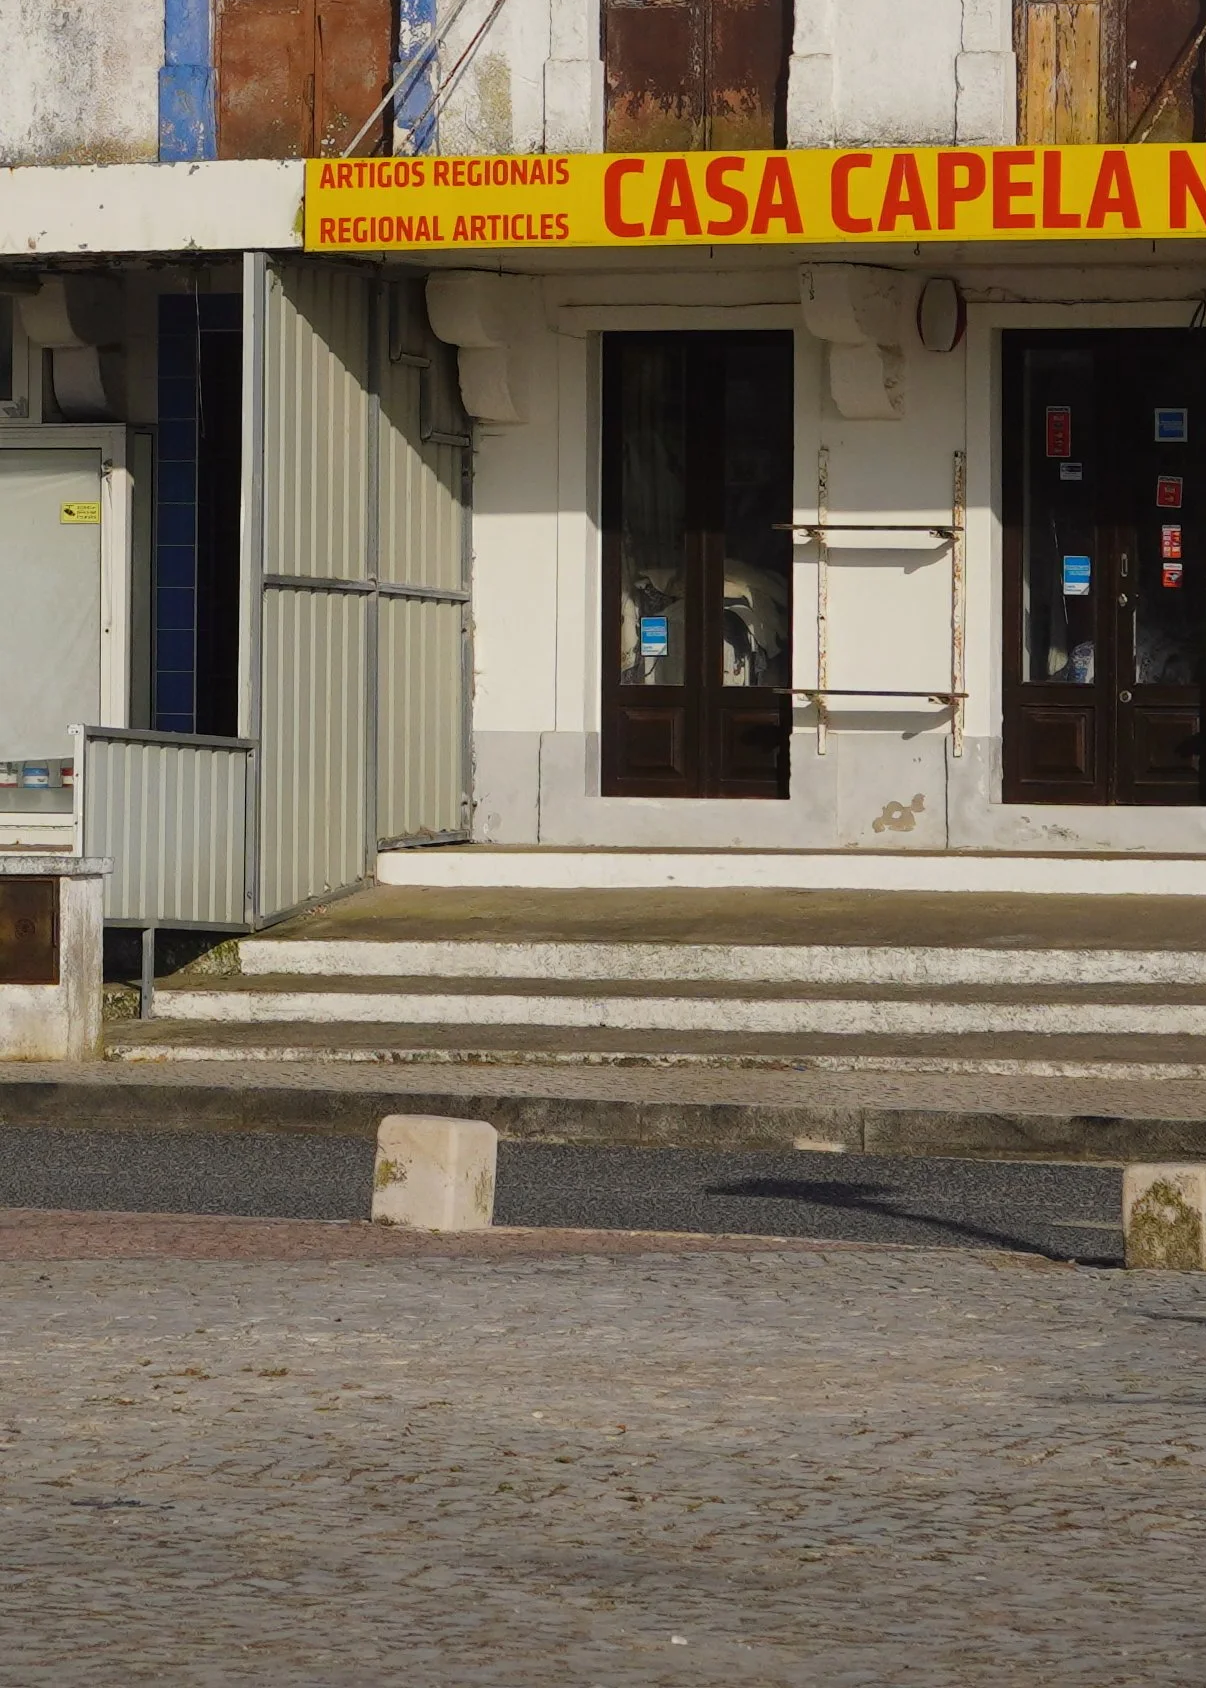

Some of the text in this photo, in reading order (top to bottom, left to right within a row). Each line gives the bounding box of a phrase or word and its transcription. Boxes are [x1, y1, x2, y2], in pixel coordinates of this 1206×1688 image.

[319, 158, 571, 189] ARTIGOS REGIONAIS
[603, 153, 805, 238] CASA
[830, 150, 1142, 235] CAPELA
[319, 213, 571, 243] REGIONAL ARTICLES
